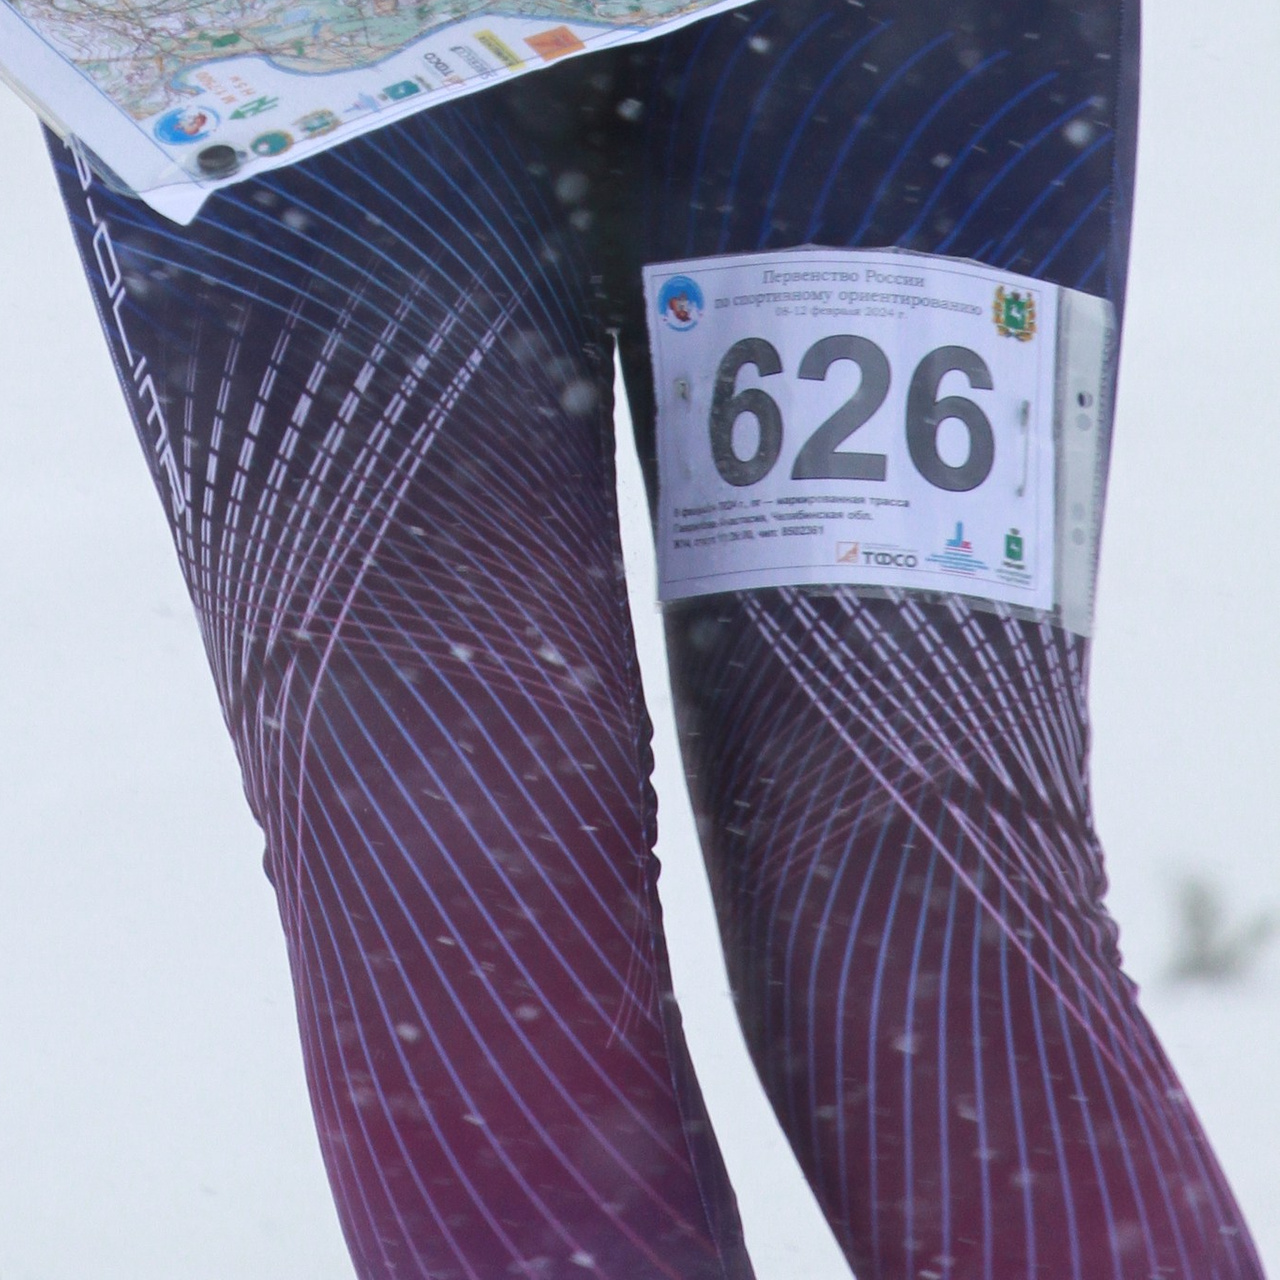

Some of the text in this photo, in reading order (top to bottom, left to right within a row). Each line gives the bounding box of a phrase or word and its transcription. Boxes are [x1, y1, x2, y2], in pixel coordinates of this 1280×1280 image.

[762, 268, 925, 287] Первенство России
[714, 289, 983, 316] по спортивному ориентированию
[810, 305, 862, 319] февраля
[865, 306, 895, 318] 2024
[71, 133, 186, 518] P-OLIMP
[708, 334, 995, 492] 626
[776, 495, 865, 507] маркированная
[870, 496, 910, 509] трасса
[772, 510, 844, 522] Челябинская
[847, 509, 874, 522] обл.
